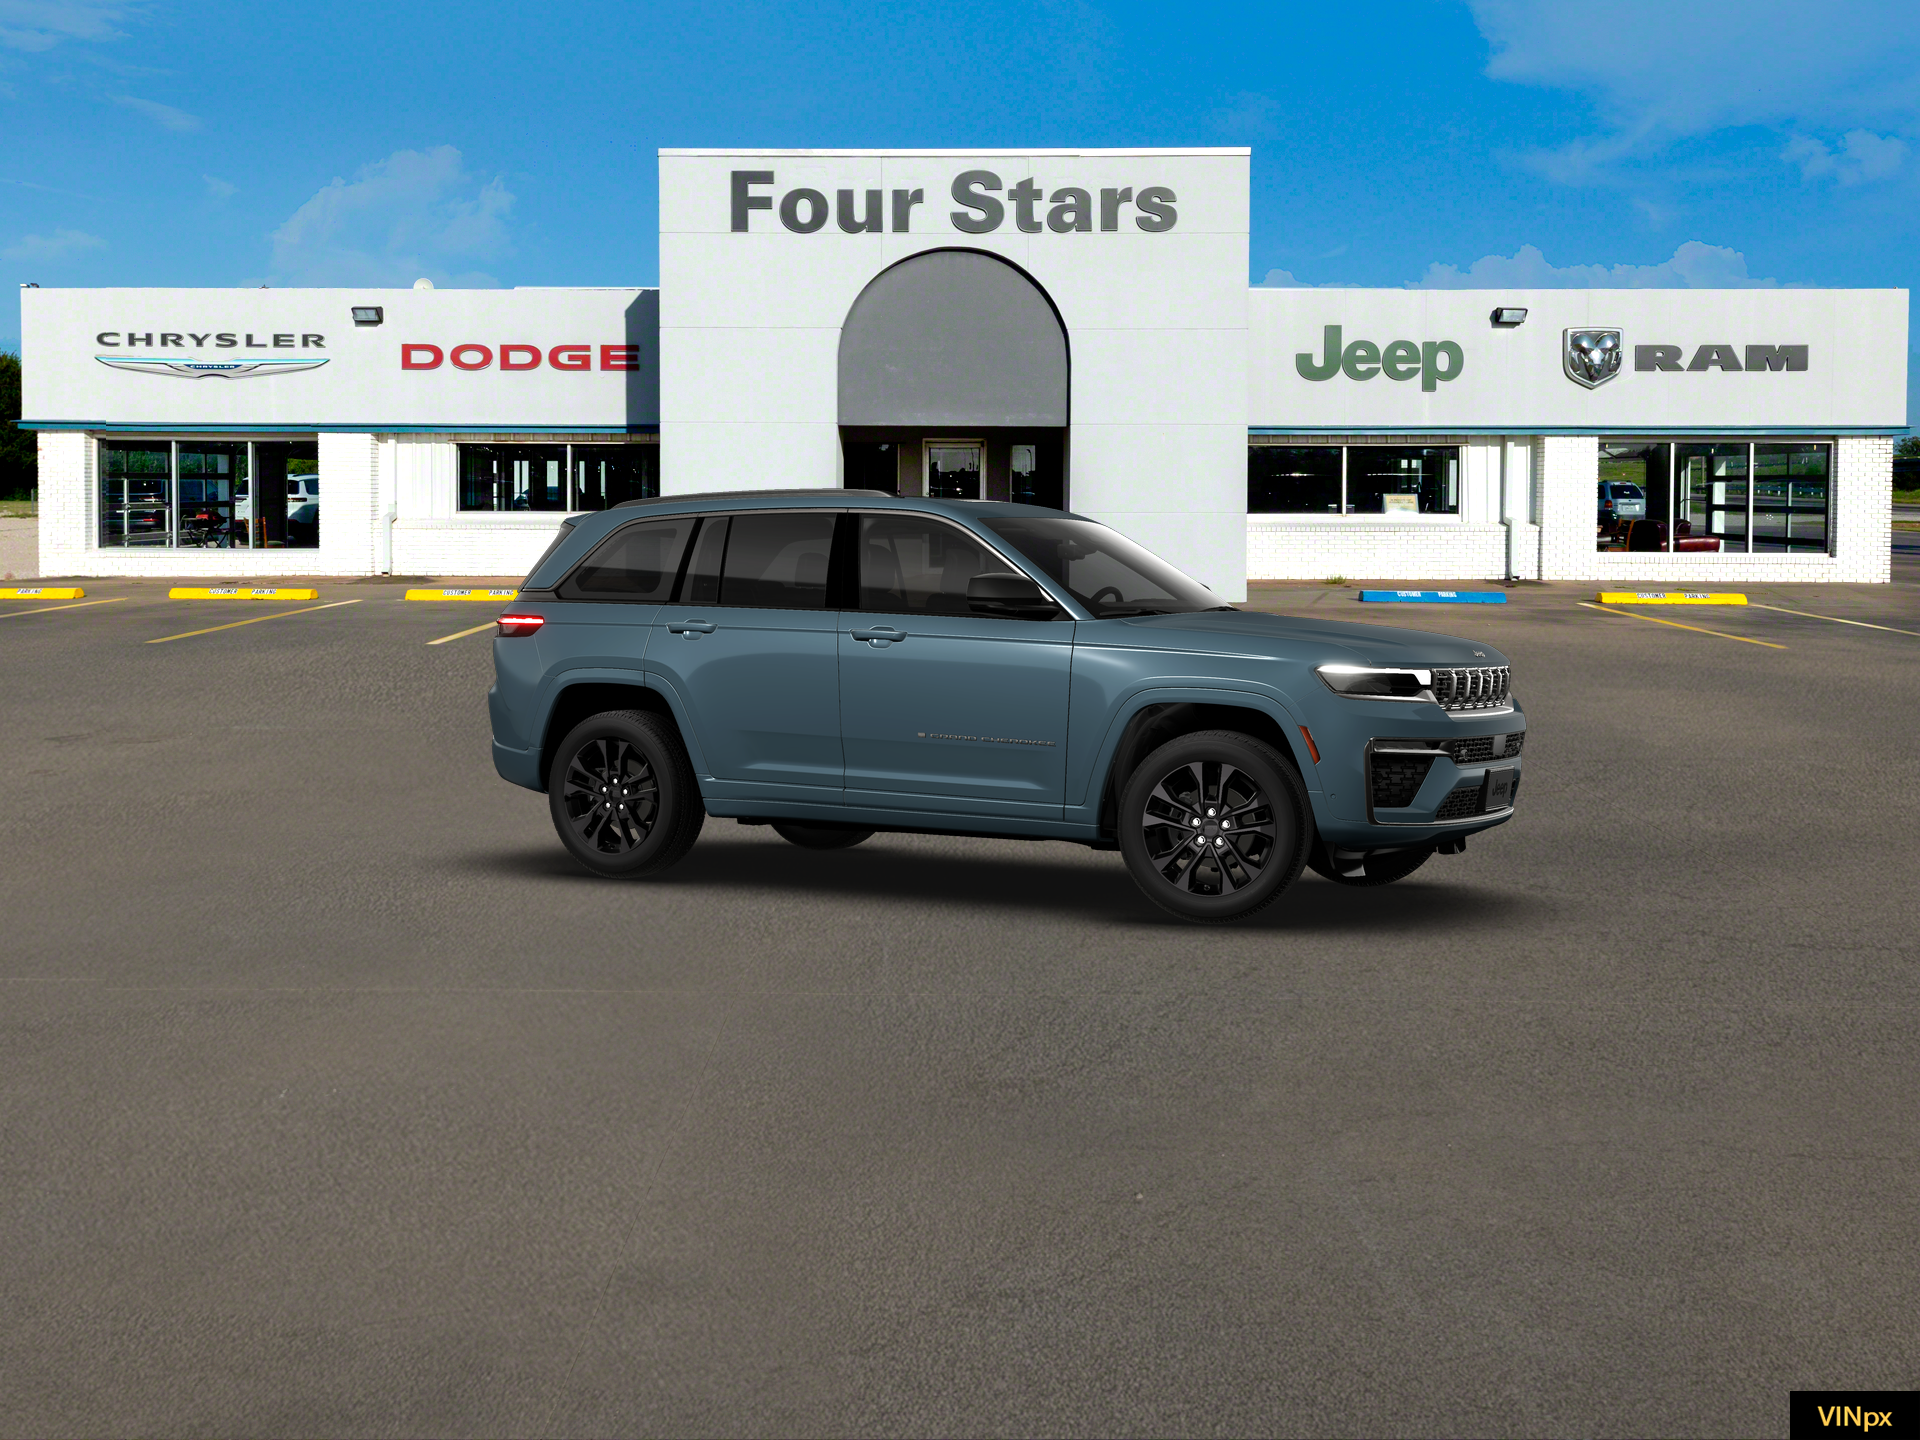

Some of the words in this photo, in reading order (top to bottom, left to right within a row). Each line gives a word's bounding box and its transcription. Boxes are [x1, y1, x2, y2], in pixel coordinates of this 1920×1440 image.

[730, 170, 924, 233] Four
[950, 170, 1178, 233] Stars
[96, 332, 326, 348] CHRYSLER
[401, 343, 640, 371] DODGE
[1295, 325, 1464, 392] Jeep
[1635, 344, 1809, 371] RAM
[930, 733, 977, 741] GRAND
[981, 736, 1056, 747] CHEROKEE
[1492, 779, 1508, 798] Jeep
